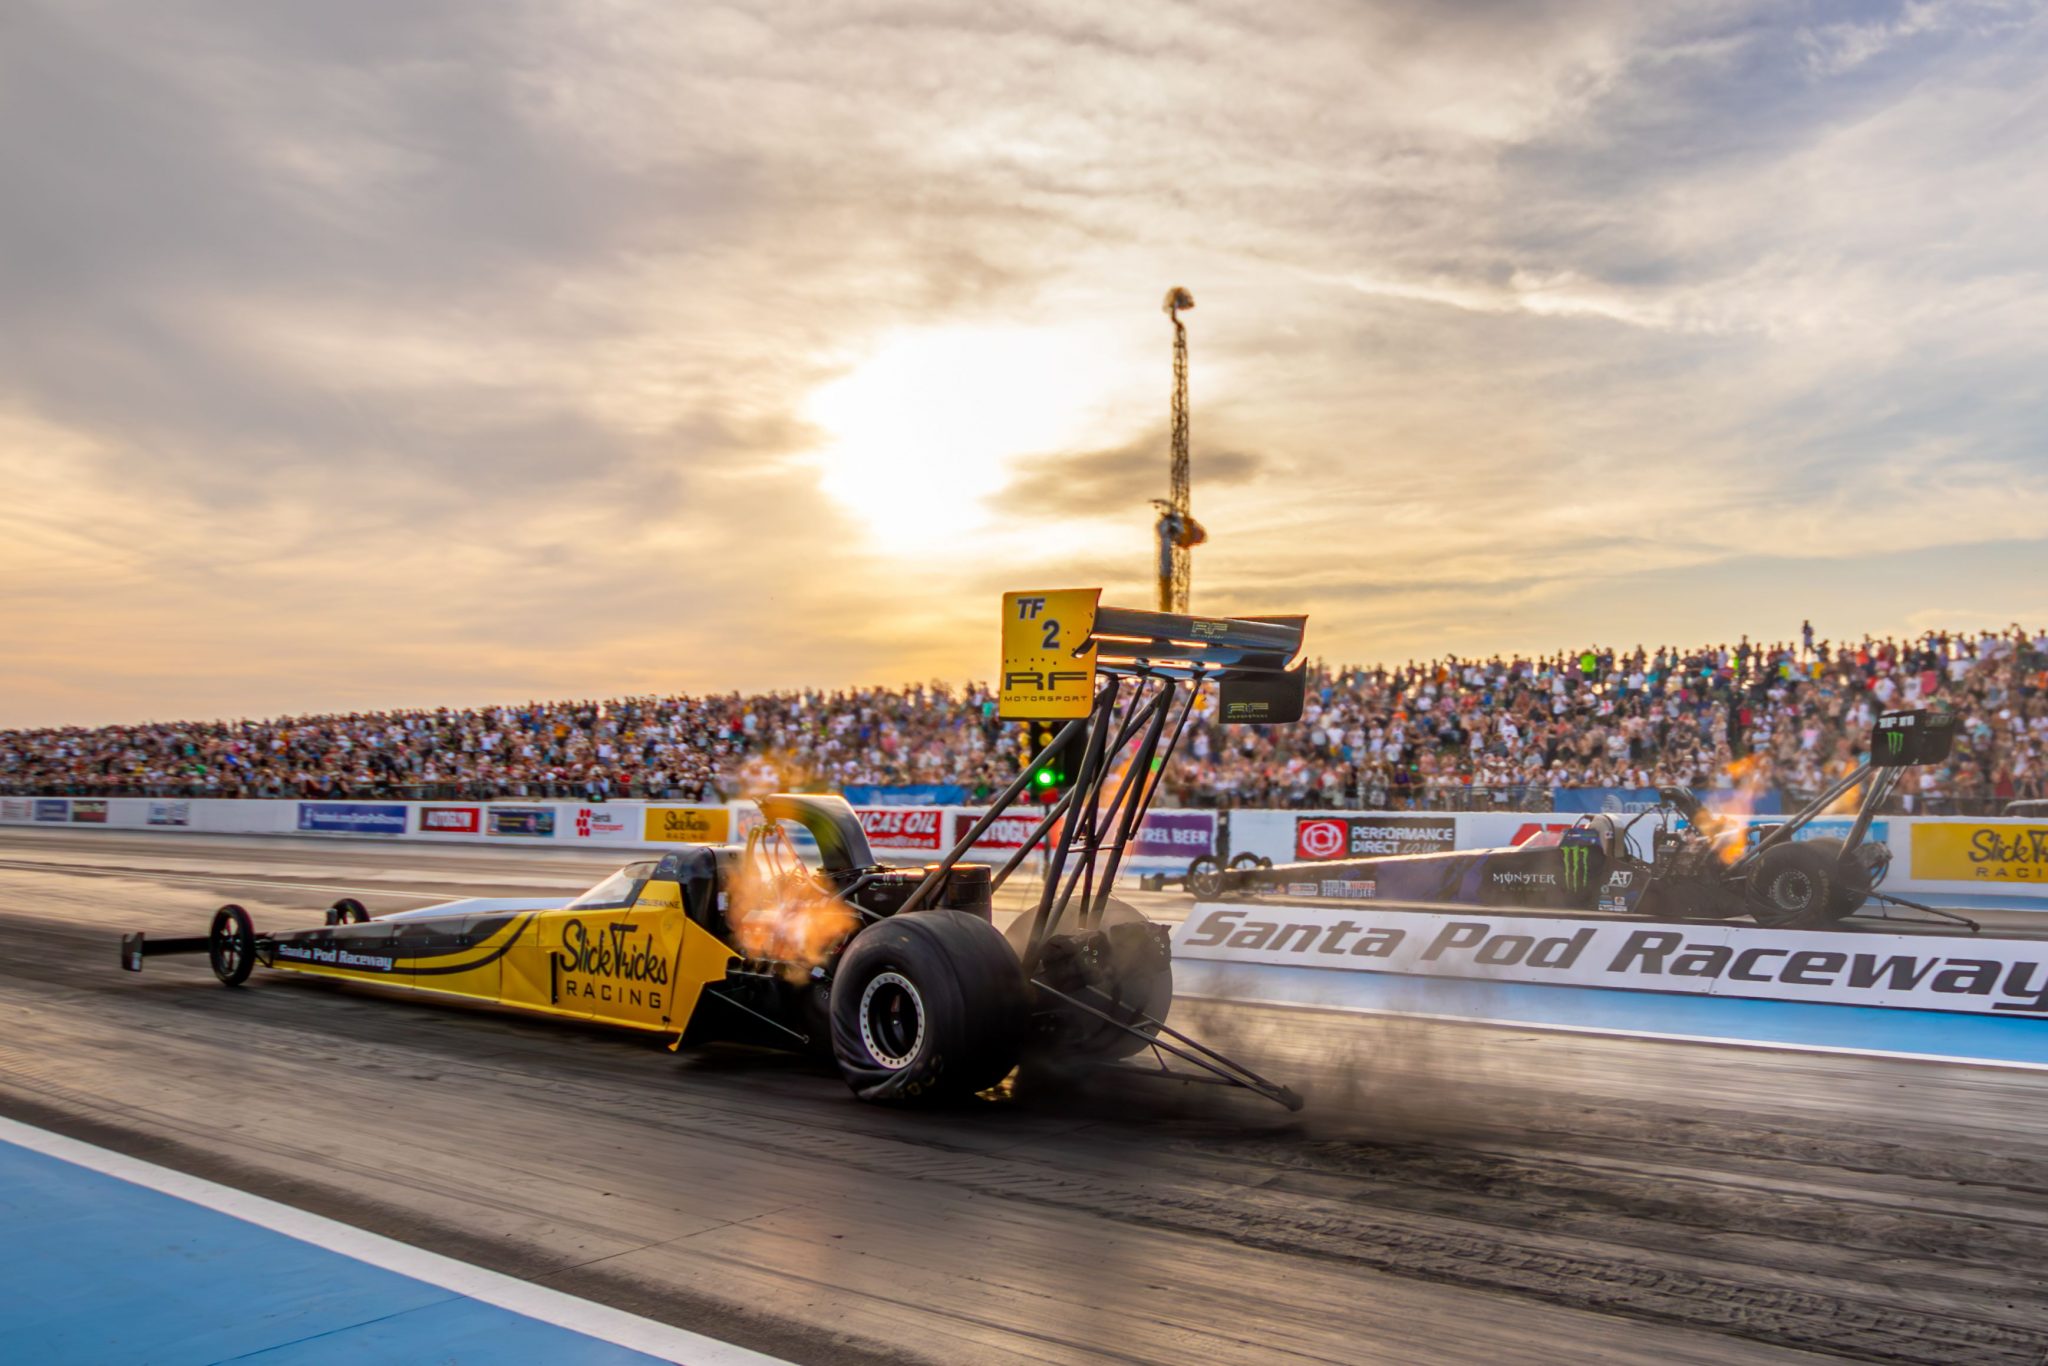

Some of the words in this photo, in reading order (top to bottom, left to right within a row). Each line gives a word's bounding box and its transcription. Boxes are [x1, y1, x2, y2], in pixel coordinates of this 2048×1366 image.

[1017, 597, 1045, 620] TF
[1042, 619, 1060, 649] 2
[1191, 621, 1228, 634] RF
[1004, 671, 1088, 691] RF
[904, 812, 937, 834] OIL
[1351, 826, 1453, 841] PERFORMANCE
[1171, 828, 1208, 845] BEER
[1351, 841, 1400, 854] DIRECT
[1492, 871, 1557, 886] MONSTER
[278, 944, 312, 960] Santa
[312, 948, 337, 963] Pod
[338, 950, 393, 972] Raceway
[1184, 911, 1406, 958] Santa
[1420, 922, 1597, 970] Pod
[1606, 930, 2048, 1011] Raceway
[566, 980, 662, 1009] RACING
